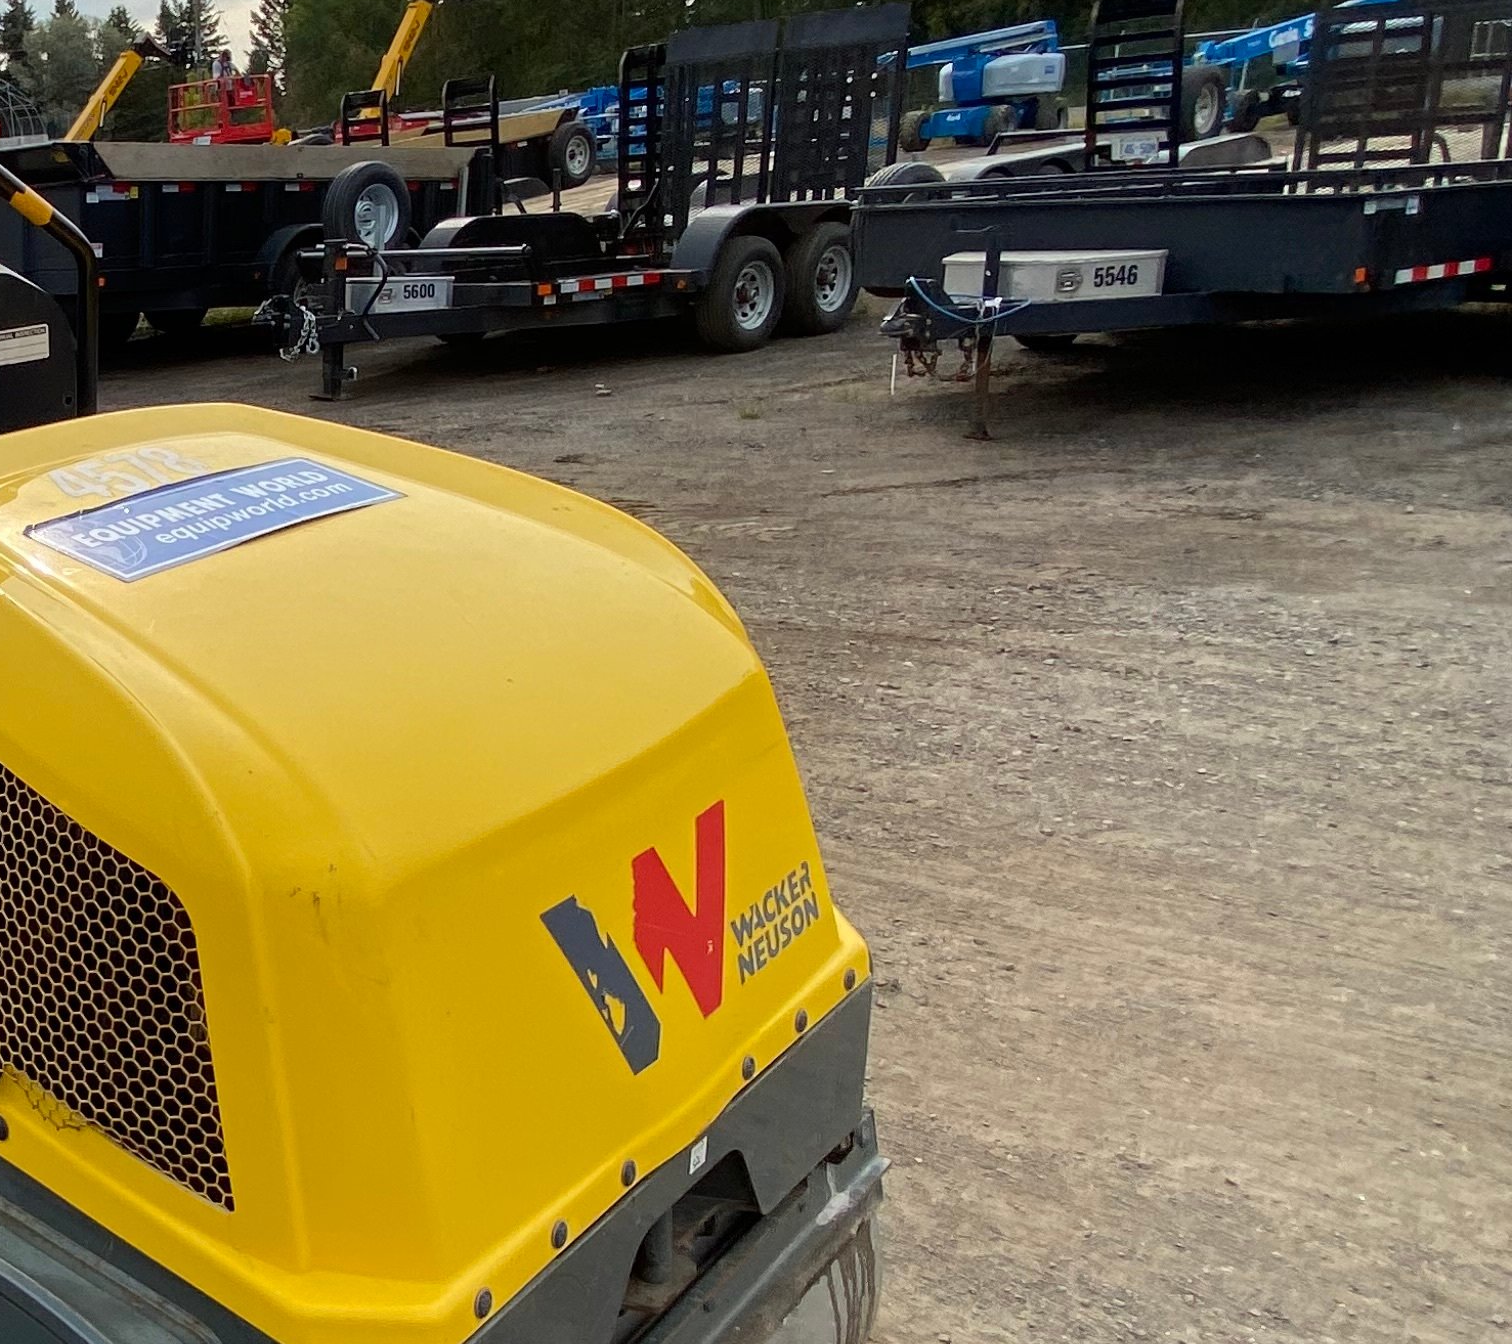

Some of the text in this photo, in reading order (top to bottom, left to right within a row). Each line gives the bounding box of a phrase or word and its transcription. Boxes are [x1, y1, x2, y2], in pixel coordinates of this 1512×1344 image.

[403, 283, 436, 300] 5600
[1093, 264, 1139, 288] 5546
[72, 470, 331, 548] EQUIPMENT WORLD
[155, 481, 353, 544] equipworld.com
[730, 860, 813, 947] WACKER
[737, 891, 819, 985] NEUSON
